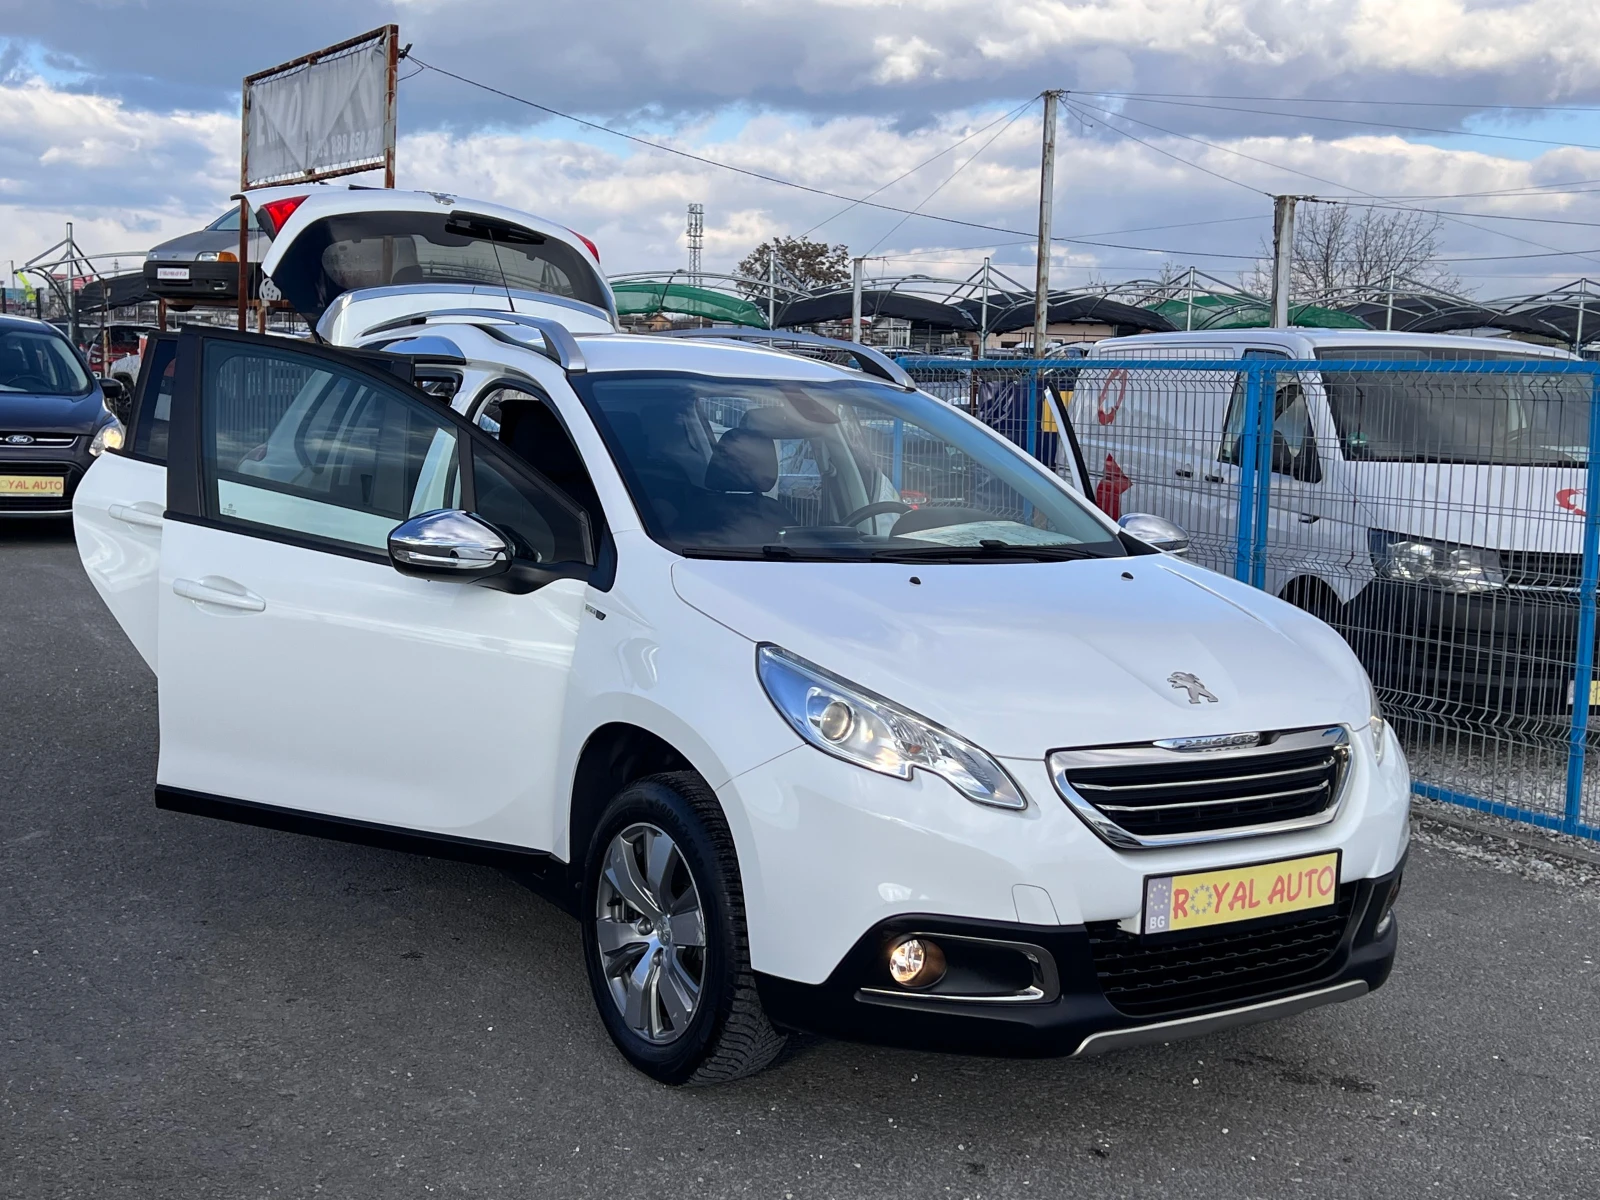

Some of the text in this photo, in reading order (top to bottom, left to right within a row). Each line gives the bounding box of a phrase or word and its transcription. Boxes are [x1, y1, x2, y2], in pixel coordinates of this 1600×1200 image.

[32, 480, 63, 491] AUTO
[1172, 865, 1335, 920] ROYAL AUTO
[1149, 915, 1166, 929] BG
